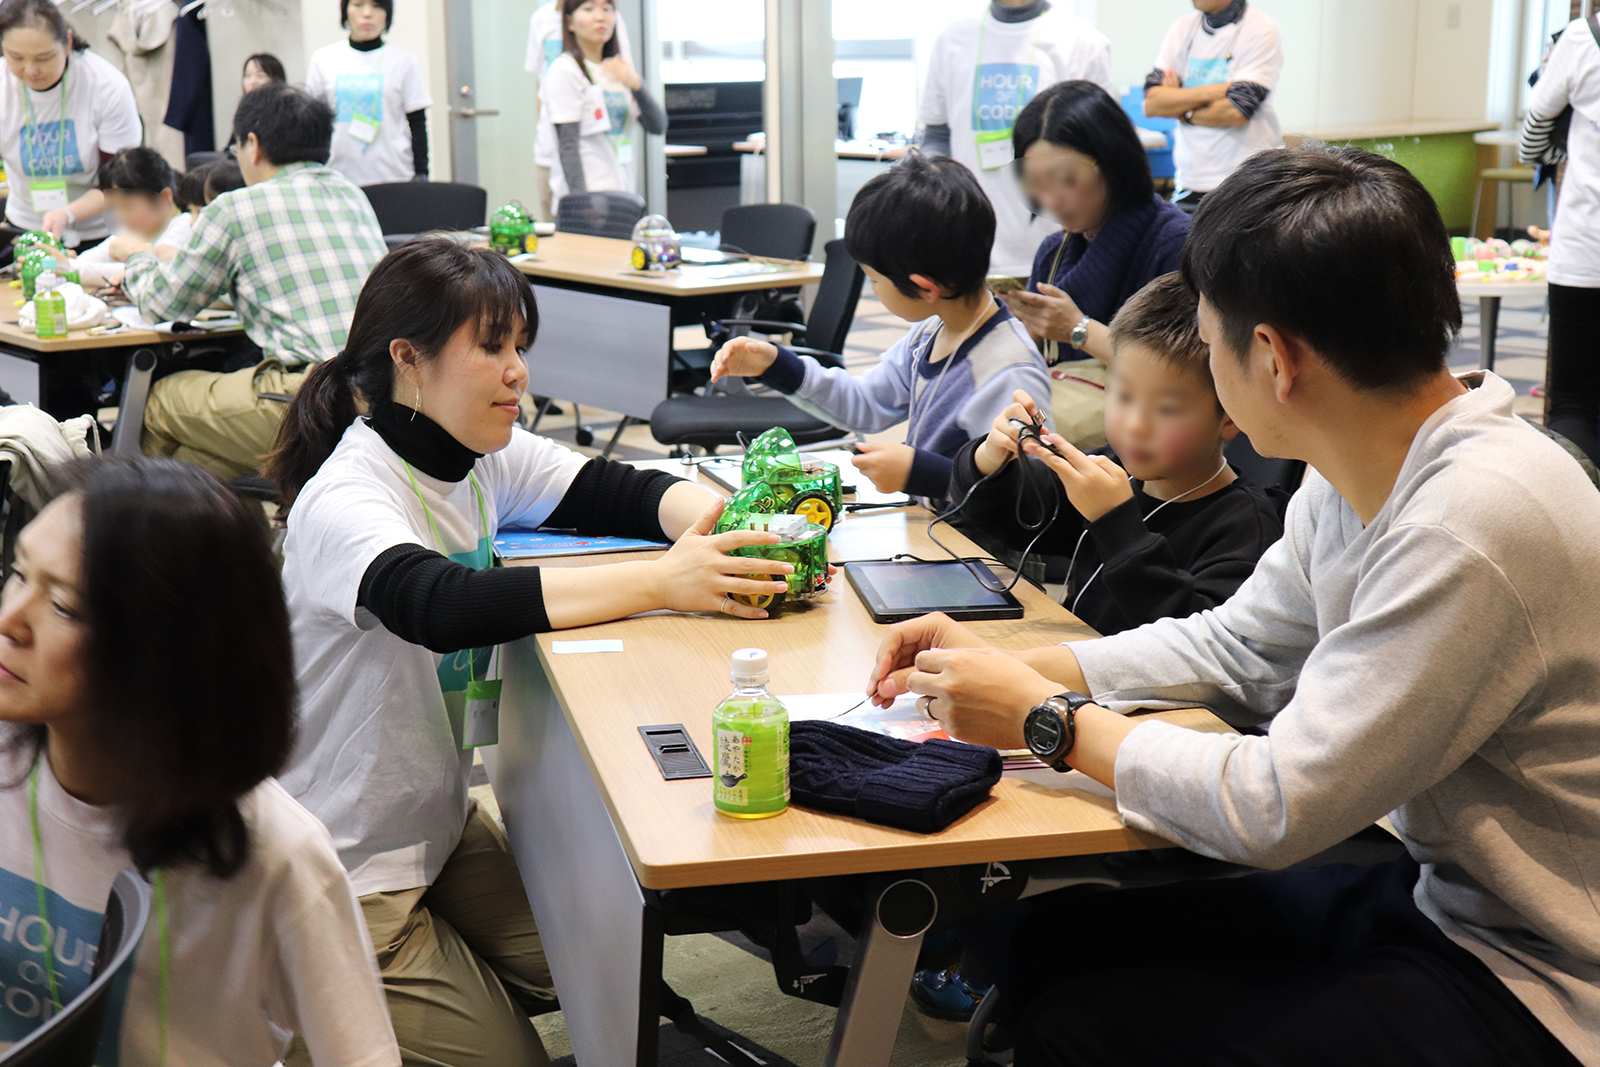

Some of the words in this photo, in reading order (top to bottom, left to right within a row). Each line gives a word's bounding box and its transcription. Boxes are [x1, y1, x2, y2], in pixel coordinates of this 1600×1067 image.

[980, 73, 1033, 90] HOUR
[995, 90, 1014, 103] OF
[27, 154, 76, 172] CODE
[731, 735, 741, 773] あやたか
